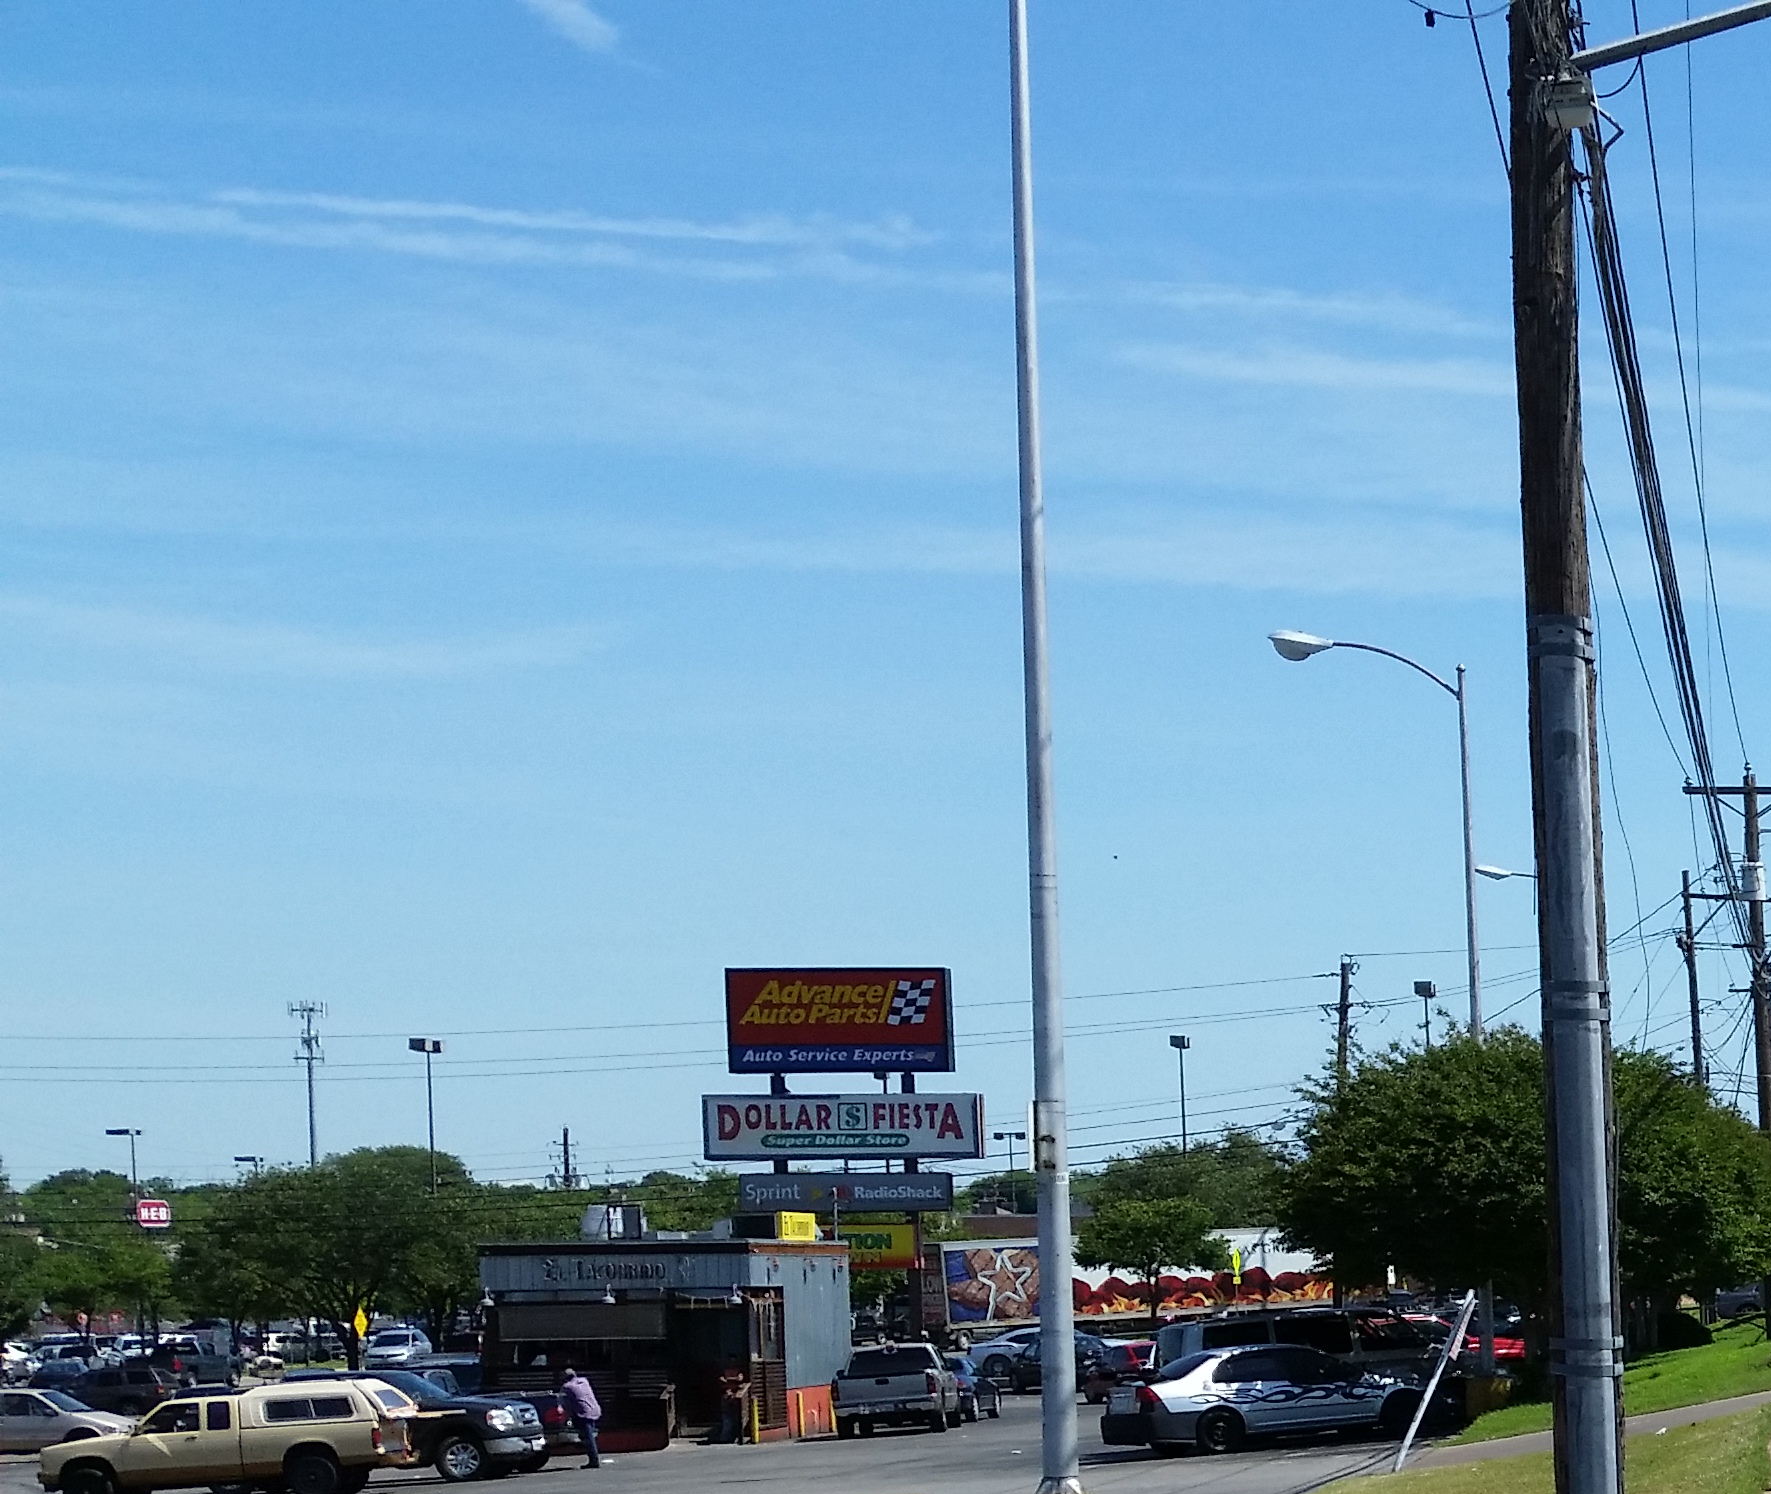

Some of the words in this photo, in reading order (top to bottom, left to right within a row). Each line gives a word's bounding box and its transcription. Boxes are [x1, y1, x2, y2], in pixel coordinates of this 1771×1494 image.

[754, 980, 884, 1004] Advance
[739, 1004, 806, 1025] Auto
[808, 1004, 879, 1025] Parts
[742, 1049, 783, 1062] Auto
[787, 1048, 848, 1062] Service
[852, 1048, 915, 1065] Experts
[717, 1103, 833, 1142] DOLLAR
[872, 1102, 965, 1140] FIESTA
[765, 1135, 811, 1149] Super
[814, 1134, 860, 1146] Dollar
[865, 1134, 908, 1147] Store
[745, 1184, 801, 1204] Sprint
[853, 1185, 943, 1200] RadioShack
